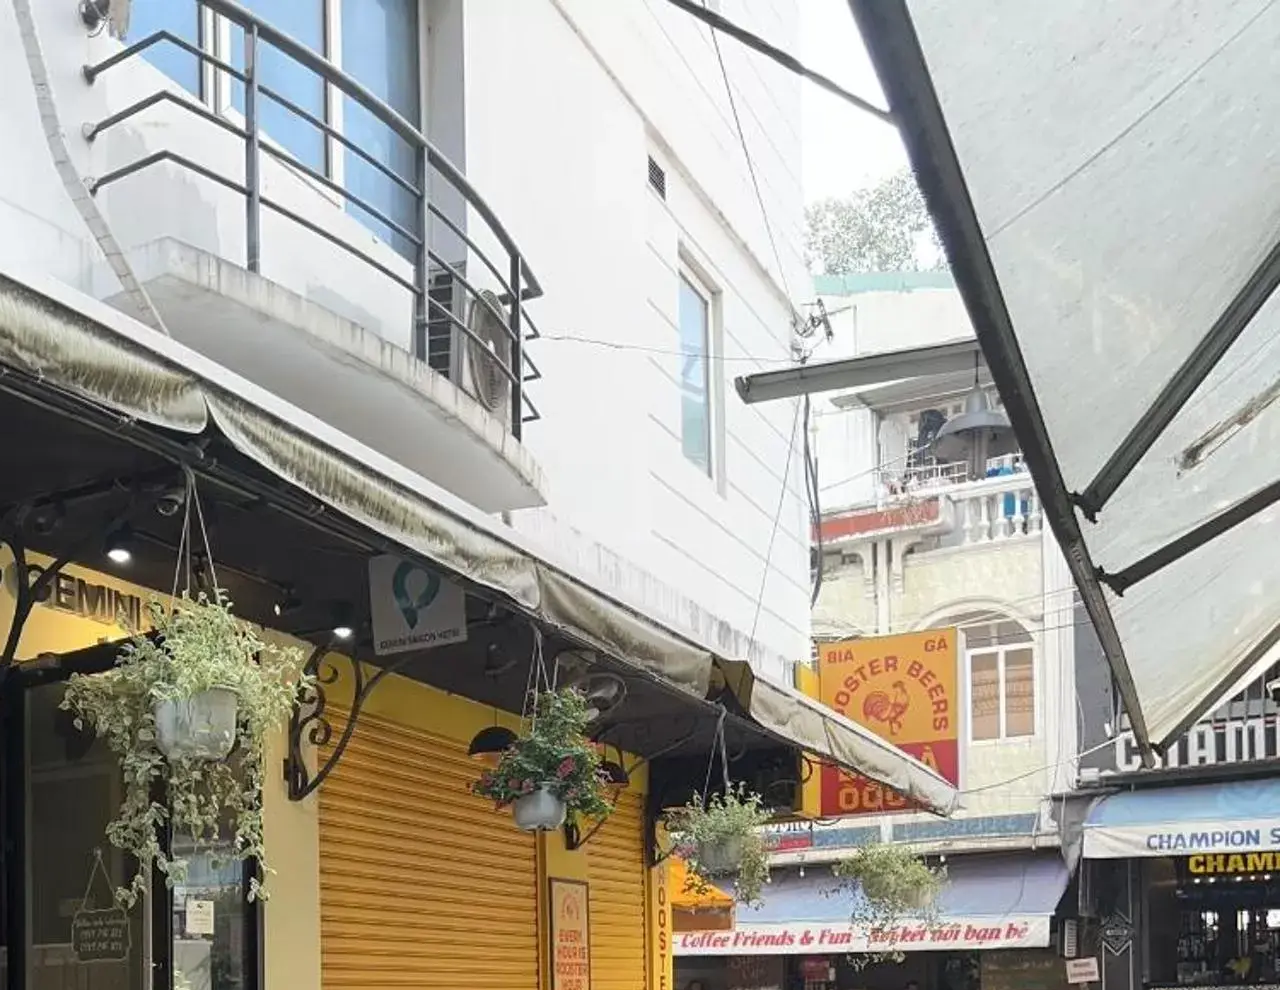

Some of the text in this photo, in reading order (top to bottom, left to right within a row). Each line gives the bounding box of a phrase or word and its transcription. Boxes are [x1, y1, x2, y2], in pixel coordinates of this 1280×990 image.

[827, 650, 854, 664] BIA
[834, 655, 949, 732] OSTER BEERS
[1146, 829, 1260, 849] CHAMPION
[681, 932, 730, 949] Coffee
[732, 930, 796, 947] Friends
[800, 929, 814, 946] &
[818, 928, 853, 945] Fun
